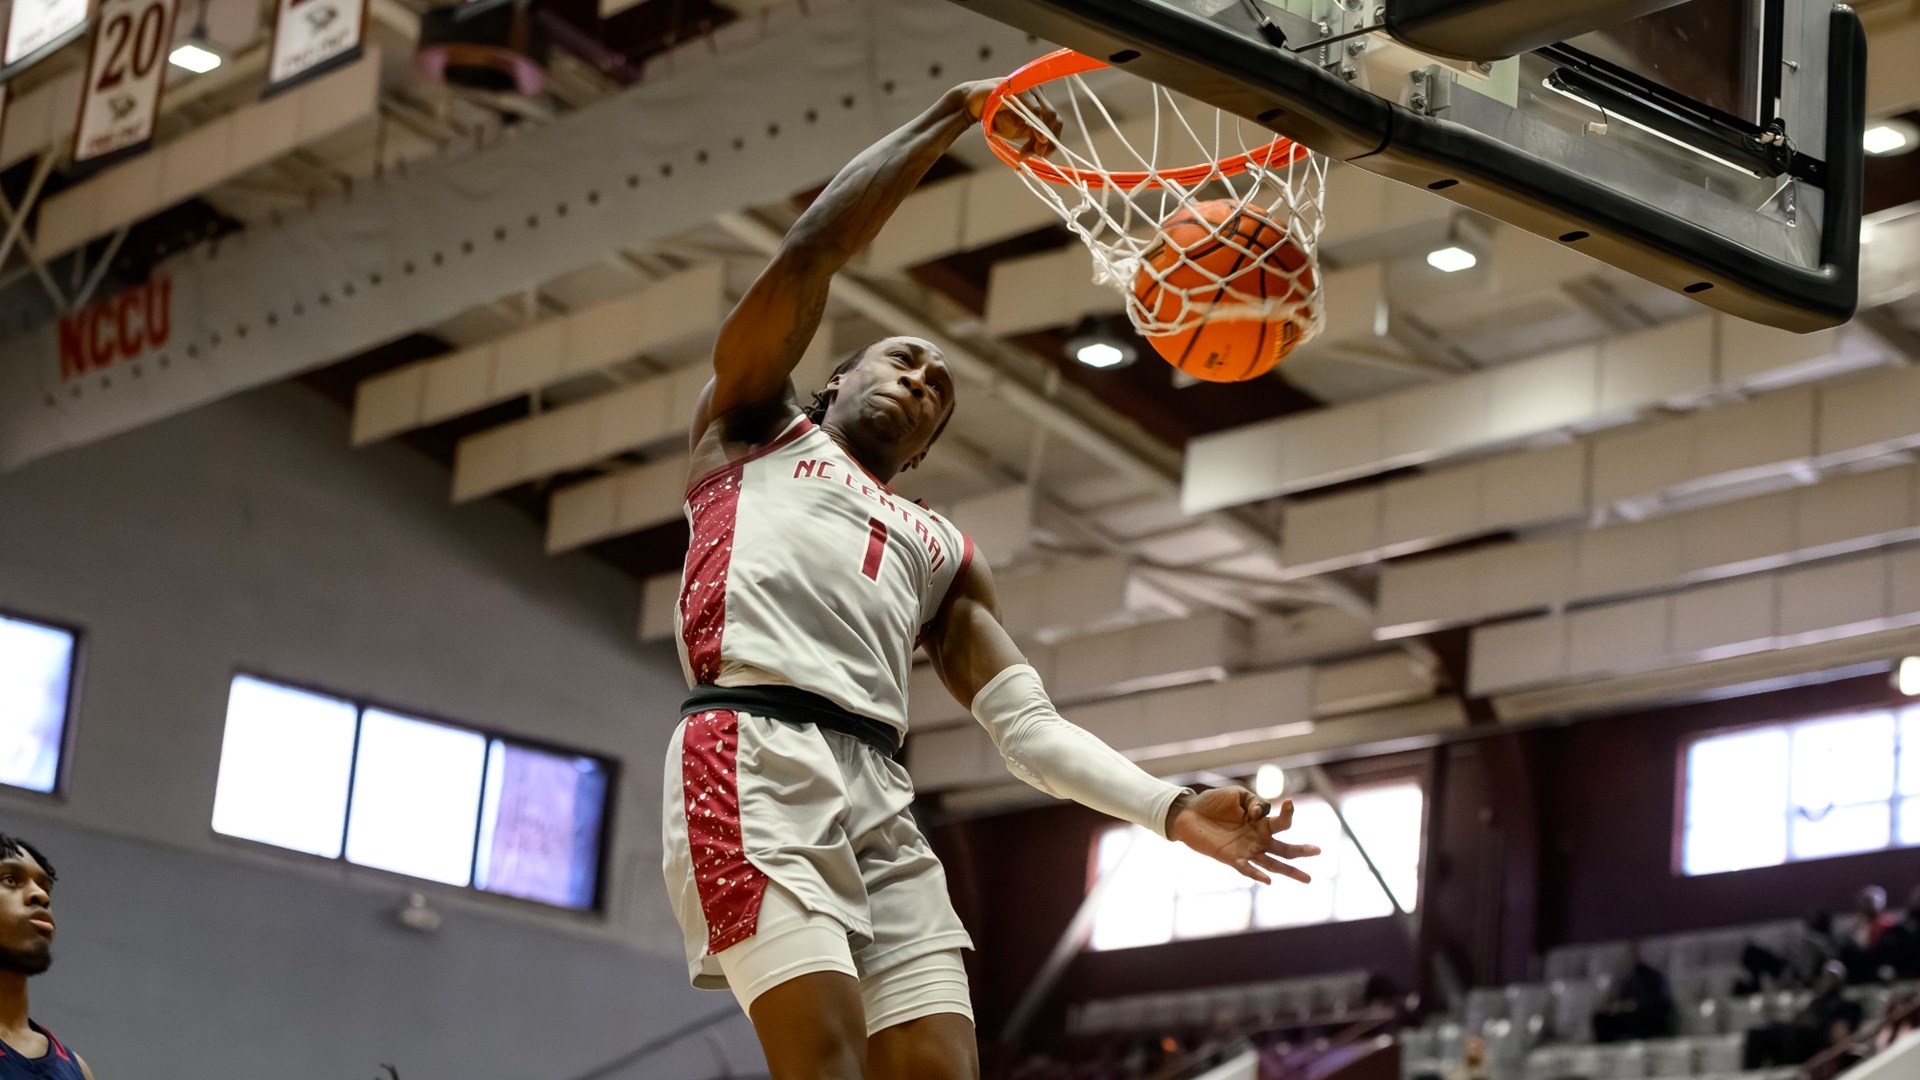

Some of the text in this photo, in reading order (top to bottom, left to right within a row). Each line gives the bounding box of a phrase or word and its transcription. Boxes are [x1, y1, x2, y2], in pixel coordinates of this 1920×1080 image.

[96, 3, 165, 91] 20
[57, 273, 173, 383] NCCU
[793, 459, 836, 479] NC
[861, 516, 887, 582] 1
